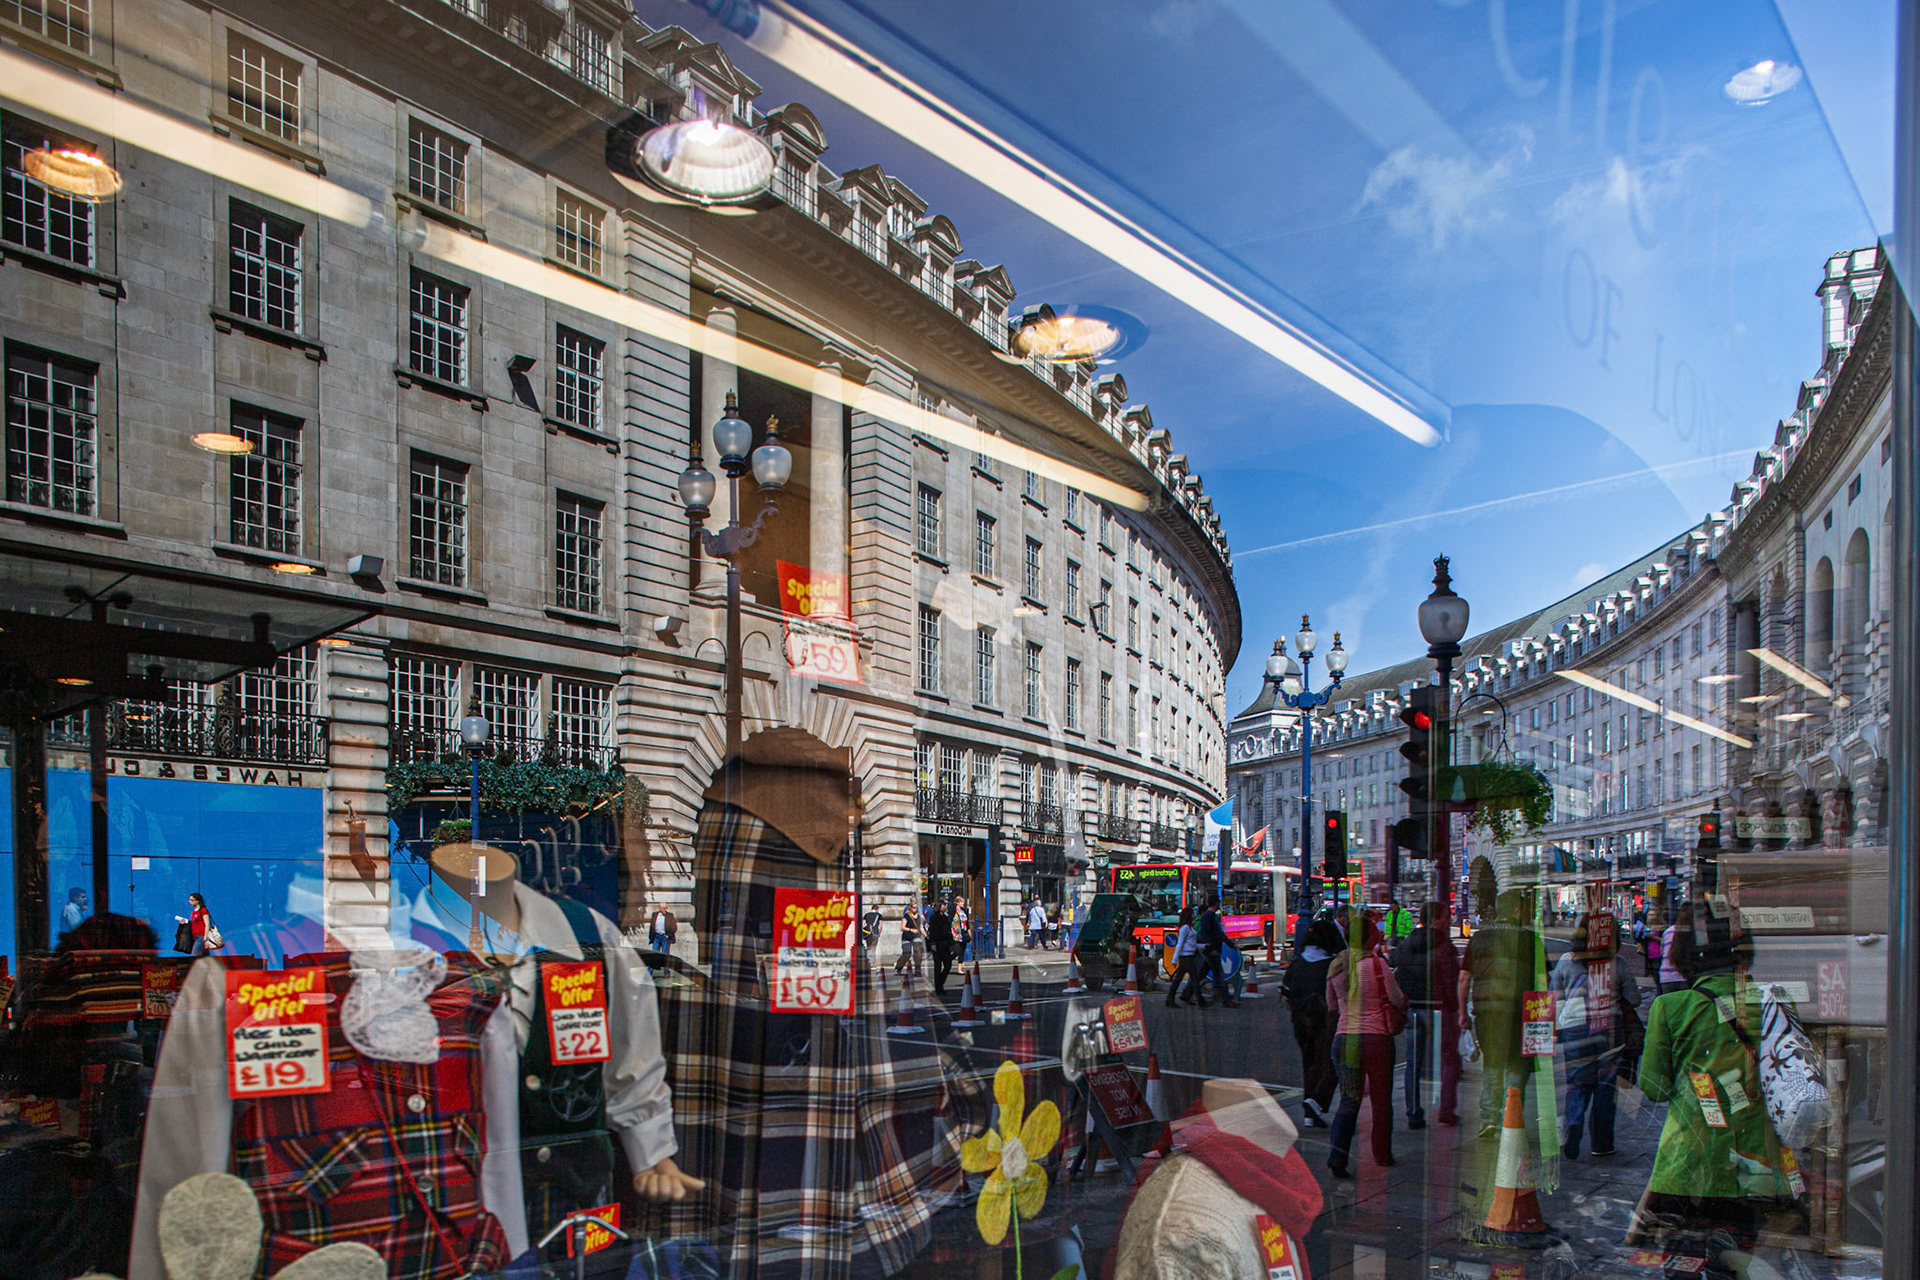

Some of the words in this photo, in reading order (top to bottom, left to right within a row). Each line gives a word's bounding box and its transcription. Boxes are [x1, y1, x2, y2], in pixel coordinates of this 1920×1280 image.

[787, 577, 840, 601] Special
[782, 896, 850, 928] Special
[1742, 913, 1780, 925] SCOTTISH
[1781, 913, 1811, 924] TARTAN
[794, 919, 845, 943] Offer
[237, 971, 314, 1006] Special
[550, 966, 597, 994] Special
[780, 975, 839, 1008] £59
[1588, 963, 1611, 999] SALE
[561, 986, 595, 1006] Offer
[1107, 997, 1136, 1016] Special
[1525, 994, 1554, 1012] Special
[253, 997, 310, 1021] Offer
[1114, 1009, 1136, 1022] Offer
[1529, 1007, 1552, 1020] Offer
[253, 1039, 302, 1050] CHILD
[559, 1031, 602, 1057] £22
[1112, 1036, 1132, 1050] £59
